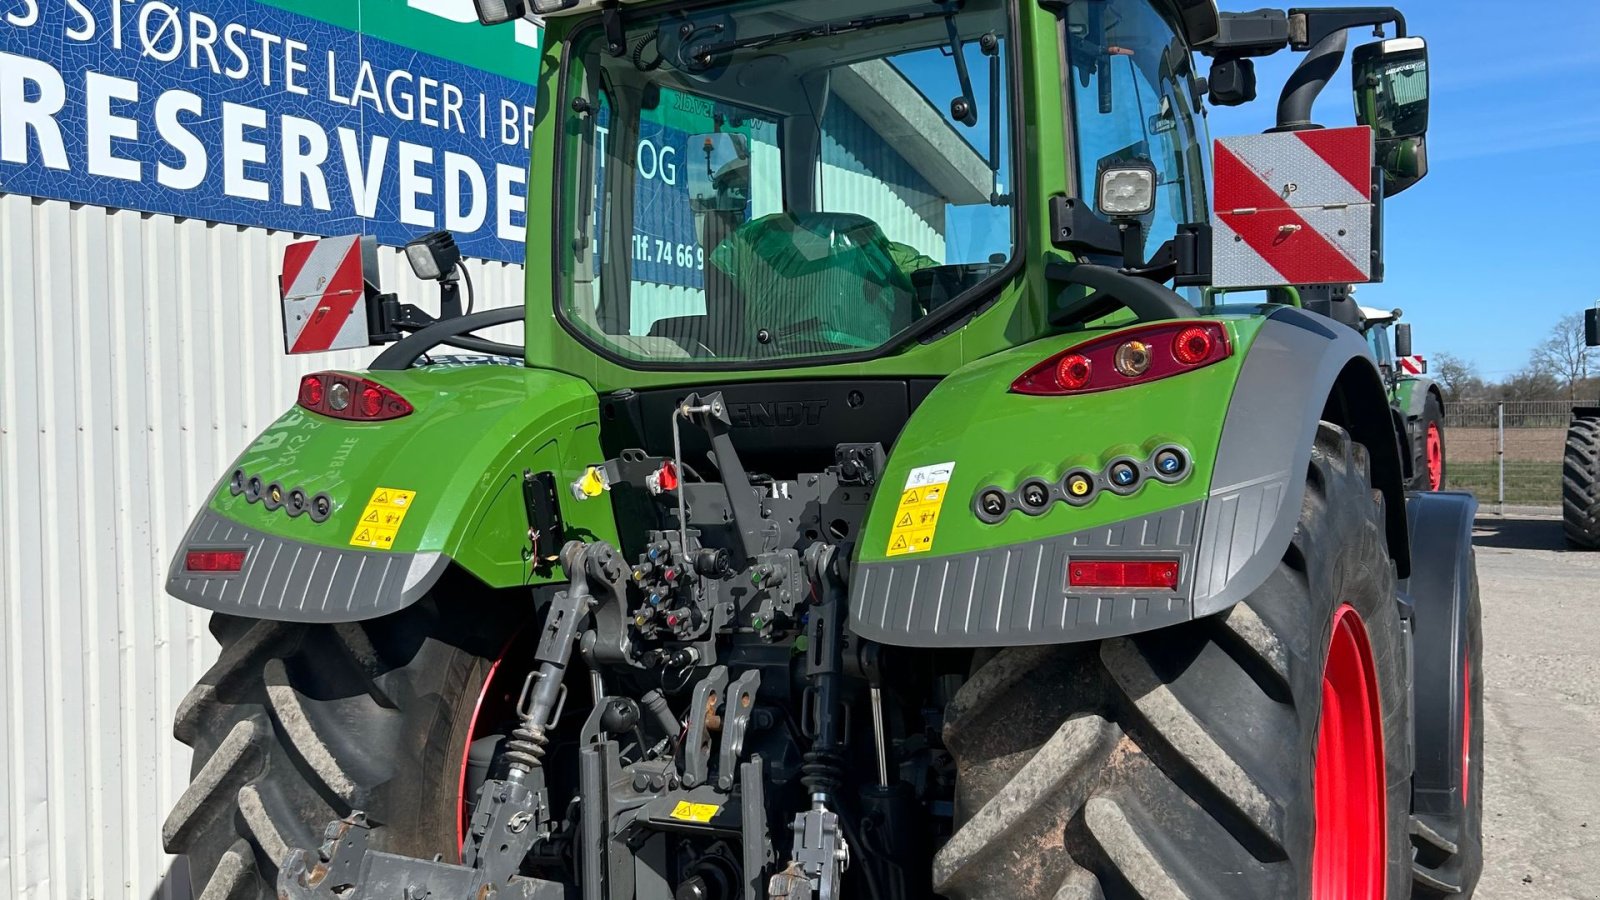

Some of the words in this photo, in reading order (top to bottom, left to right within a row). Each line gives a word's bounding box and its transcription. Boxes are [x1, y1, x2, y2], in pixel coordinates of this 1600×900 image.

[66, 0, 309, 95] STØRSTE
[328, 50, 466, 134] LAGER
[479, 92, 486, 139] I
[637, 139, 676, 186] OG
[655, 239, 673, 265] 74
[676, 243, 694, 269] 66
[727, 401, 828, 427] ENDT
